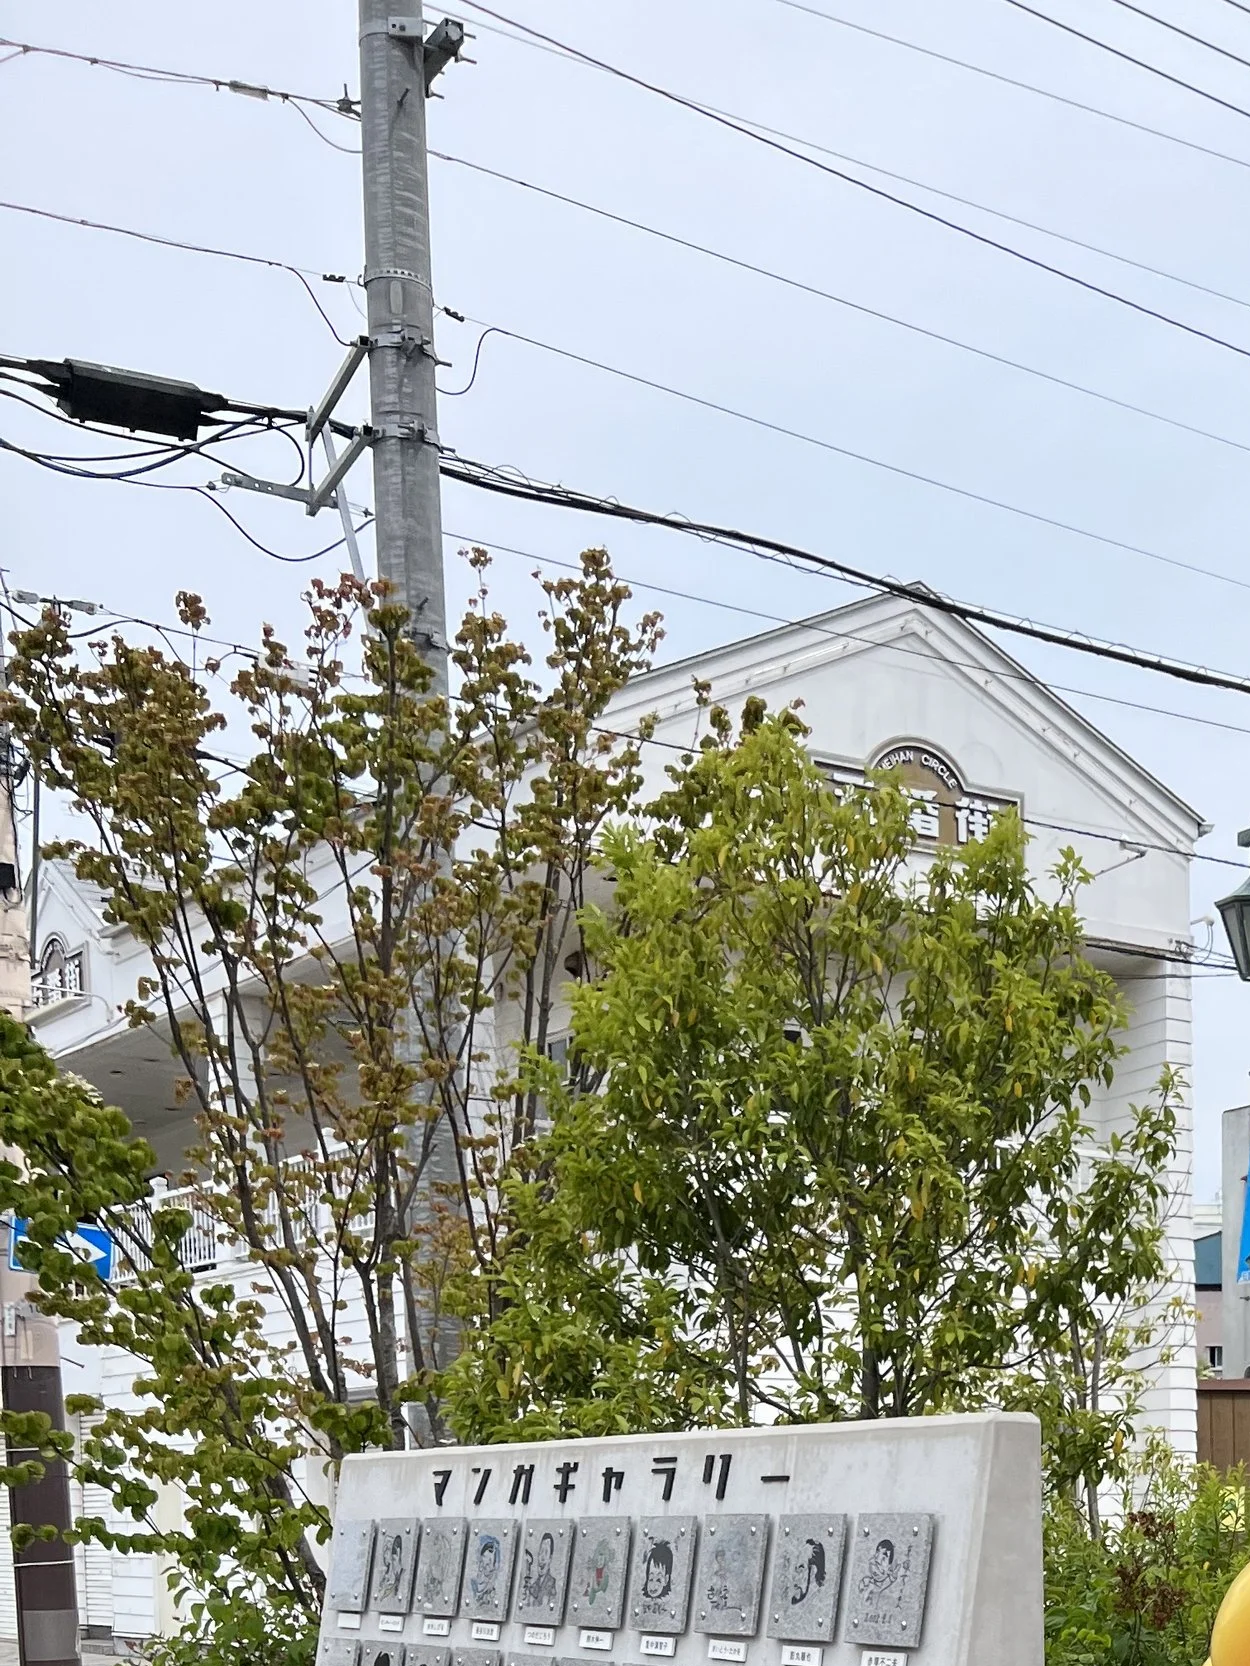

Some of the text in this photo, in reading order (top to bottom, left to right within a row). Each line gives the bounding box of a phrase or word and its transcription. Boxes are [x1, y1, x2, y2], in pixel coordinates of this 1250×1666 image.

[921, 754, 958, 789] CIRCLE
[432, 1454, 790, 1506] マンガギャラリー
